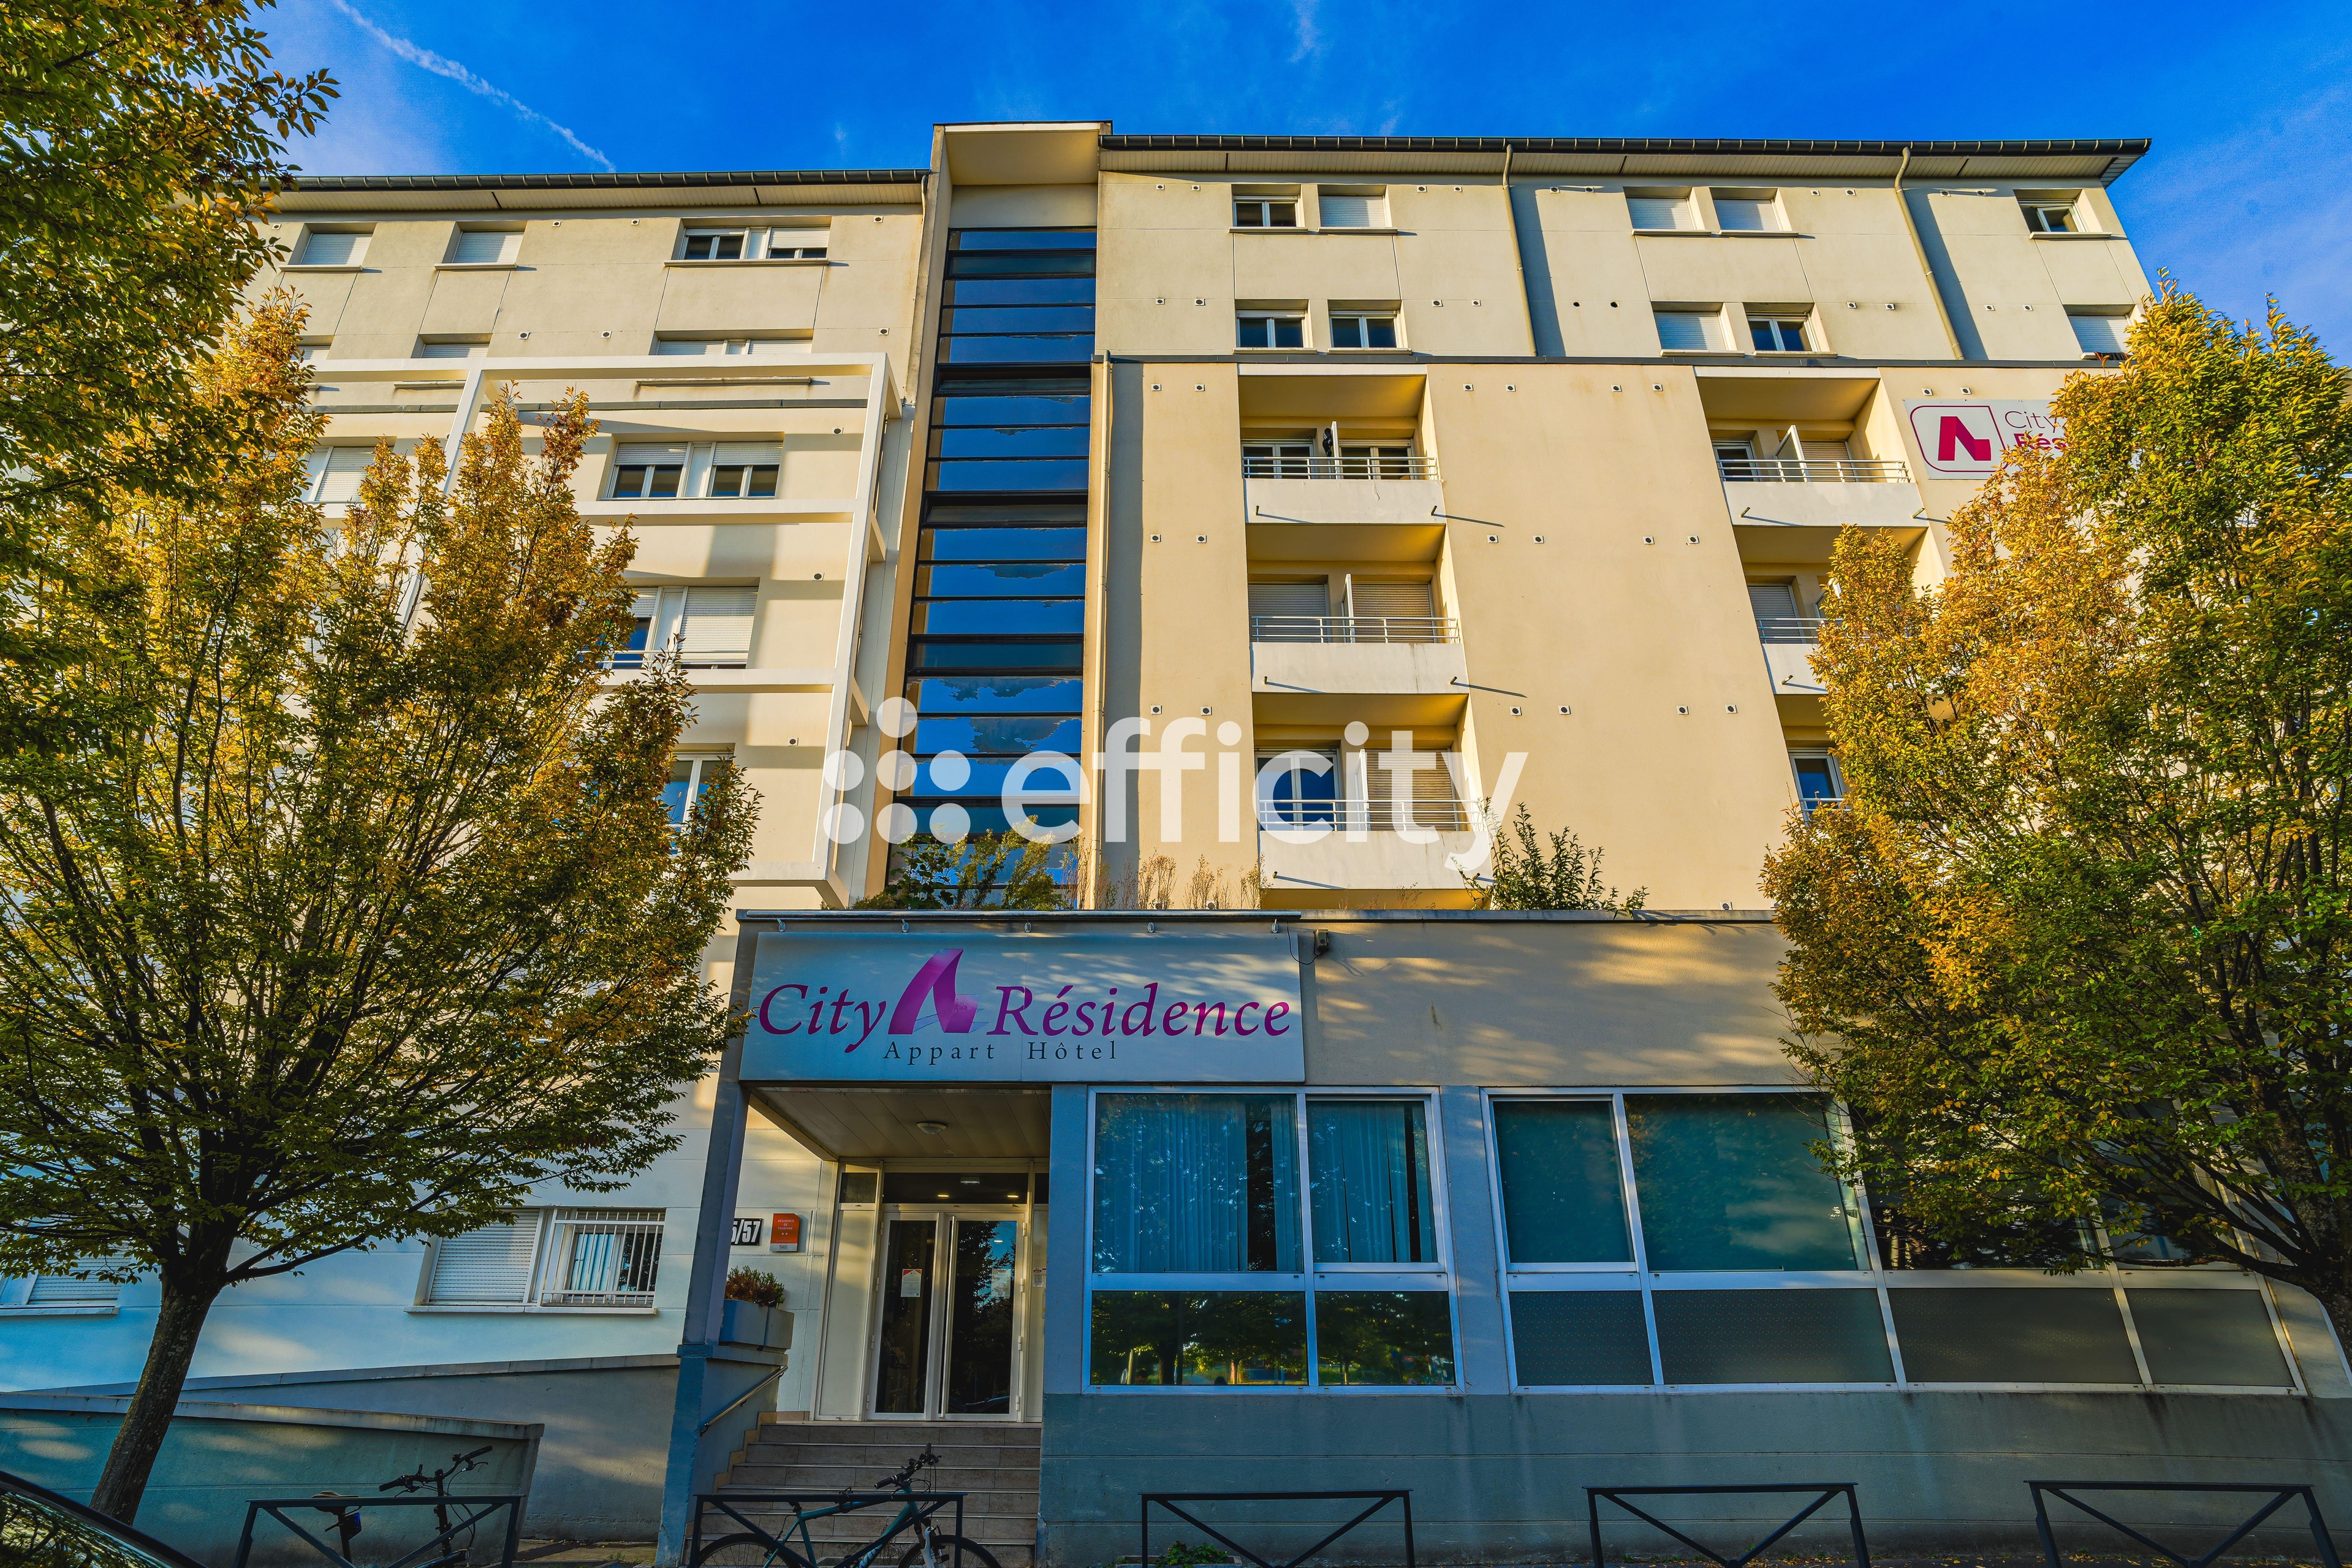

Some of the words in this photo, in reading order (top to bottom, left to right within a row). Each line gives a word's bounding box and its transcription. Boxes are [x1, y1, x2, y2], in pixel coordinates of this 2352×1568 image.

[2005, 411, 2058, 433] City
[759, 983, 887, 1053] City
[988, 982, 1291, 1036] Résidence
[882, 1040, 995, 1066] Appart
[1027, 1040, 1117, 1060] Hôtel
